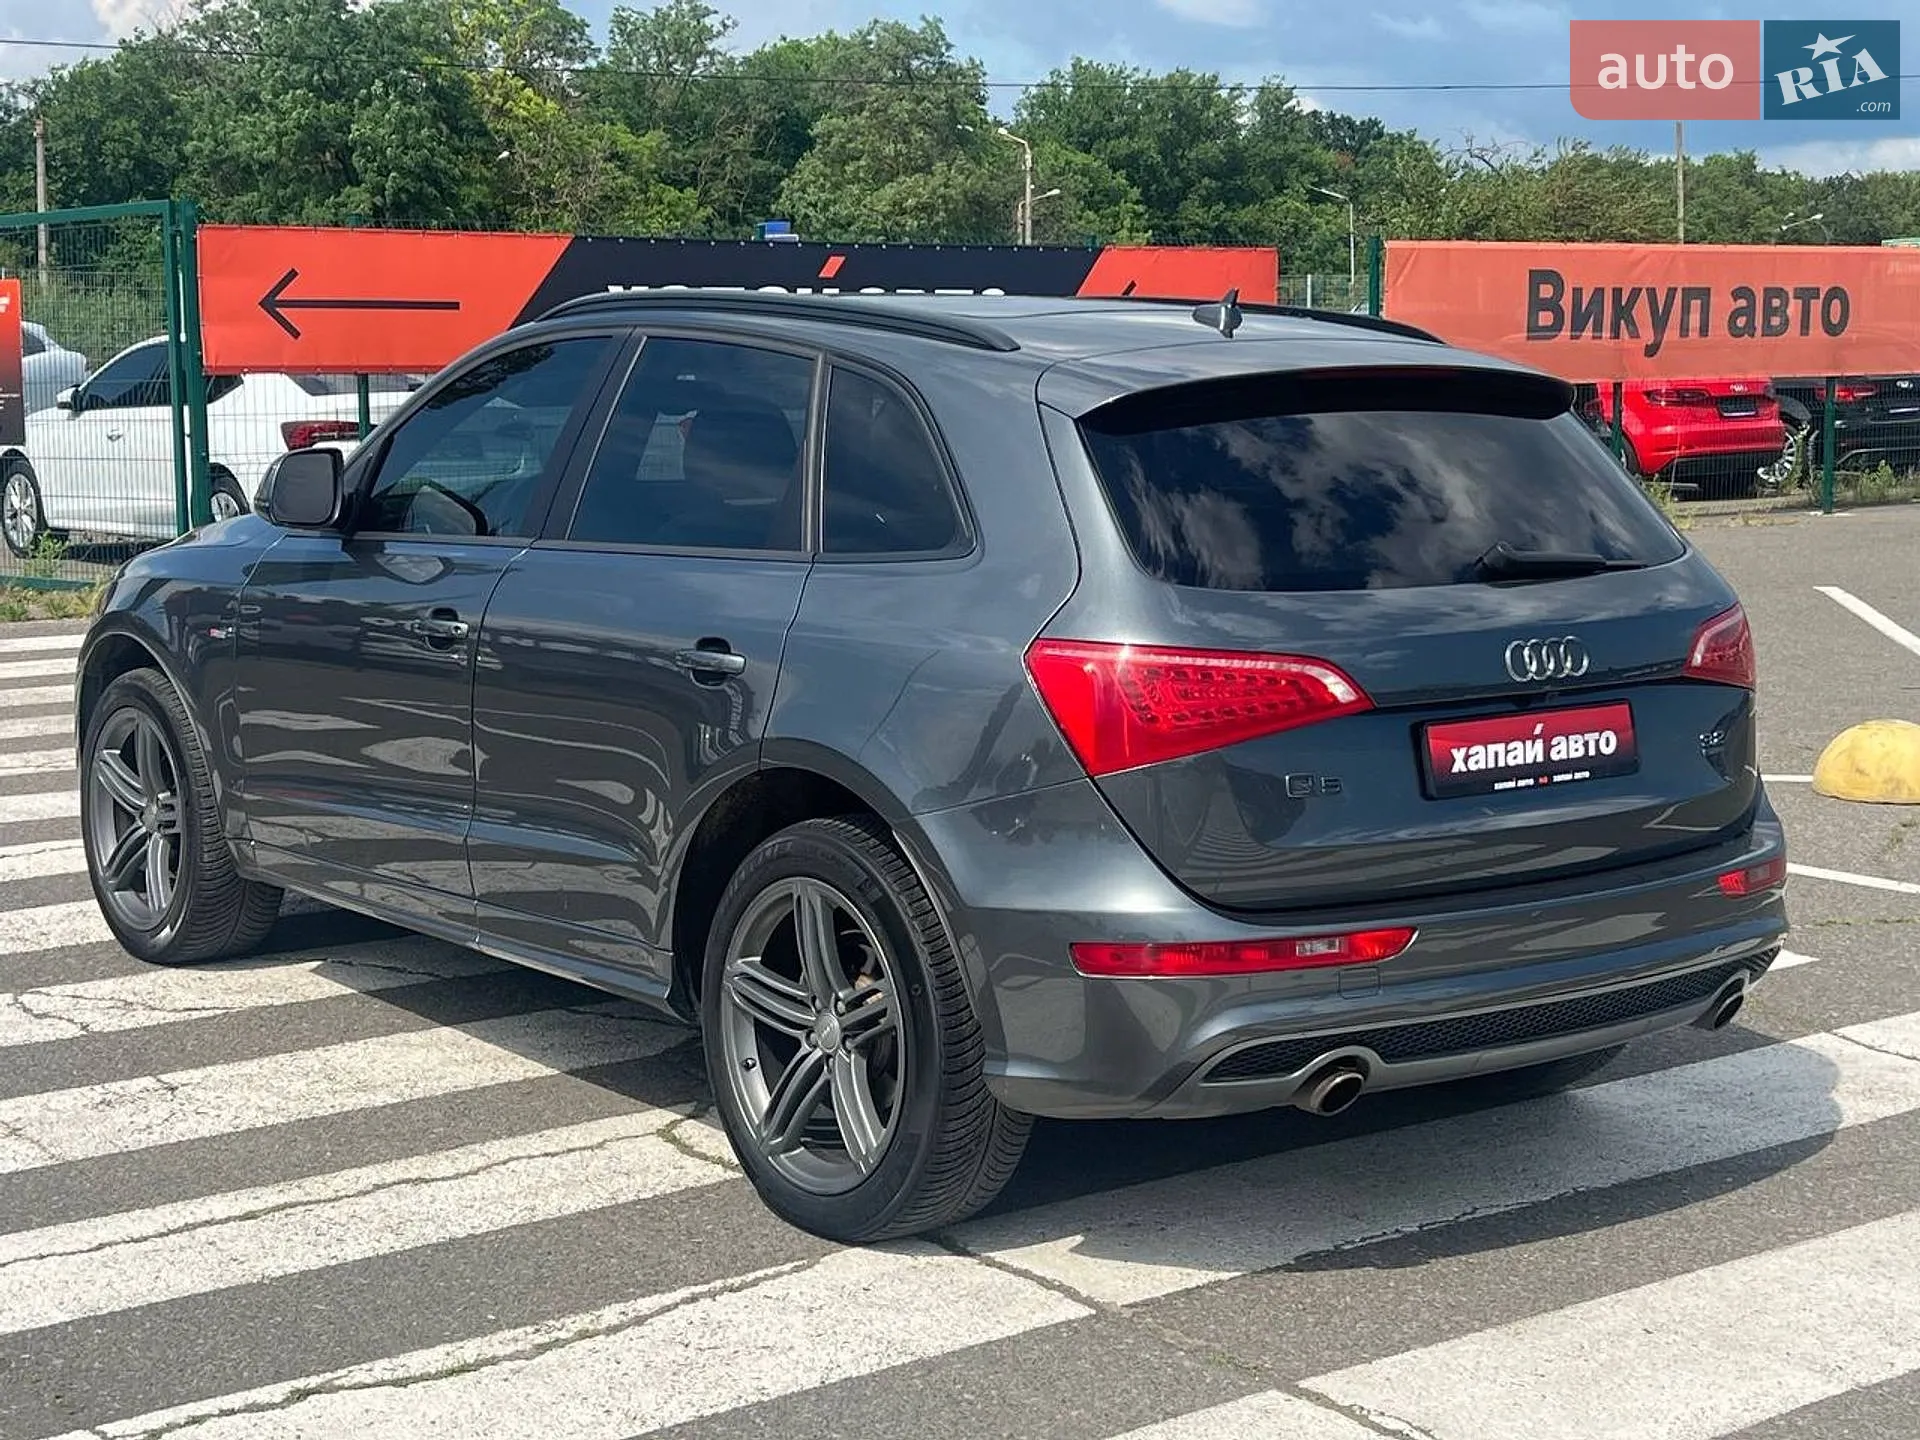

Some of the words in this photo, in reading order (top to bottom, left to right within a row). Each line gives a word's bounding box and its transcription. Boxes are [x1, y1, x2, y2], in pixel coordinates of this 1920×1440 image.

[1526, 269, 1711, 358] Викуп
[1727, 286, 1849, 338] авто
[1550, 730, 1617, 761] авто
